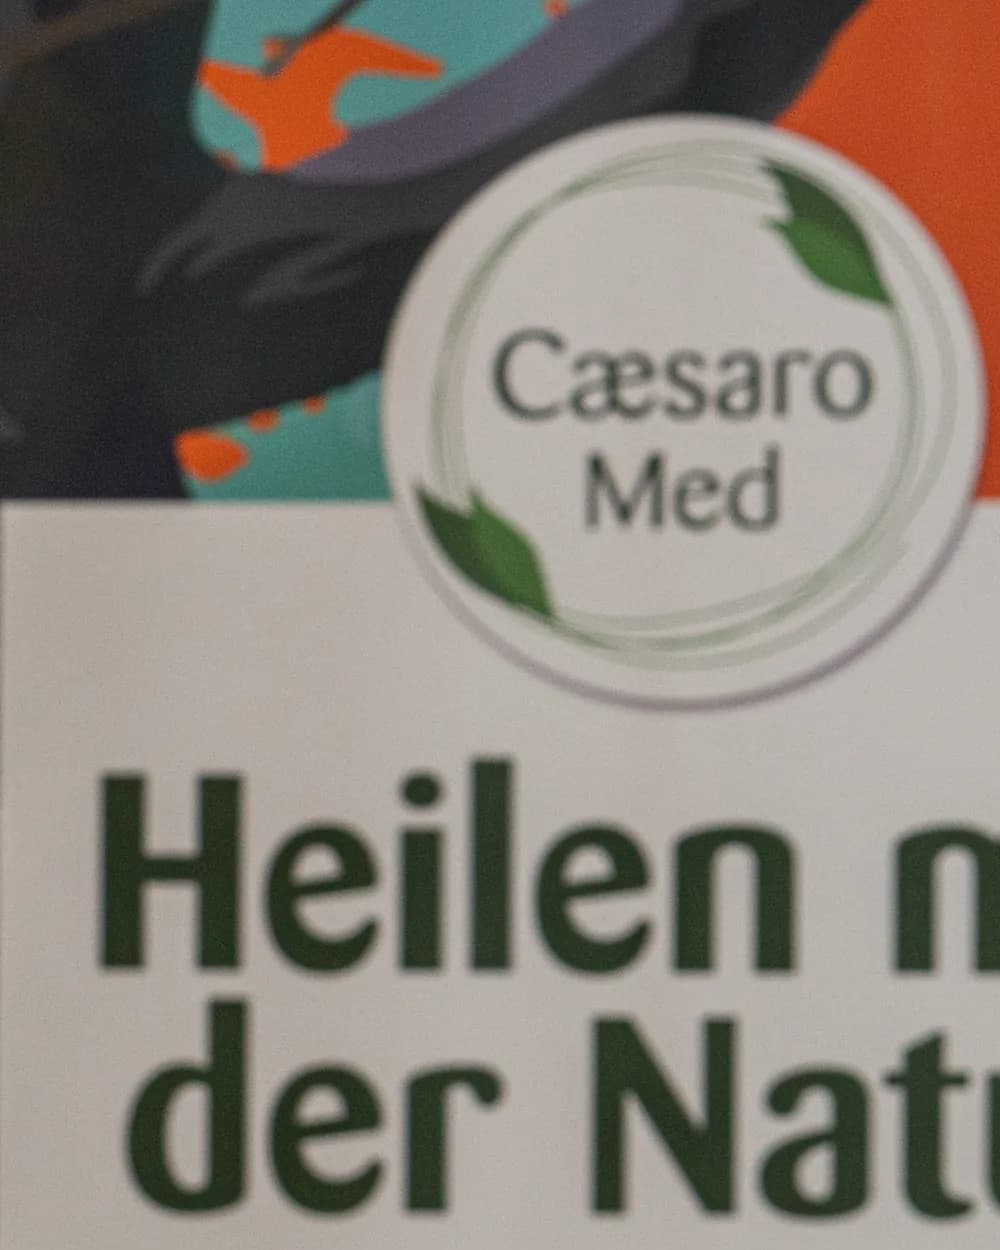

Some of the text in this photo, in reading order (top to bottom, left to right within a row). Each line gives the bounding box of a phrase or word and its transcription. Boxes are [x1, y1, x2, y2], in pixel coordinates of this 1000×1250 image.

[492, 326, 877, 422] Cæsaro
[583, 443, 783, 533] Med
[98, 755, 796, 977] Heilen
[125, 995, 505, 1218] der
